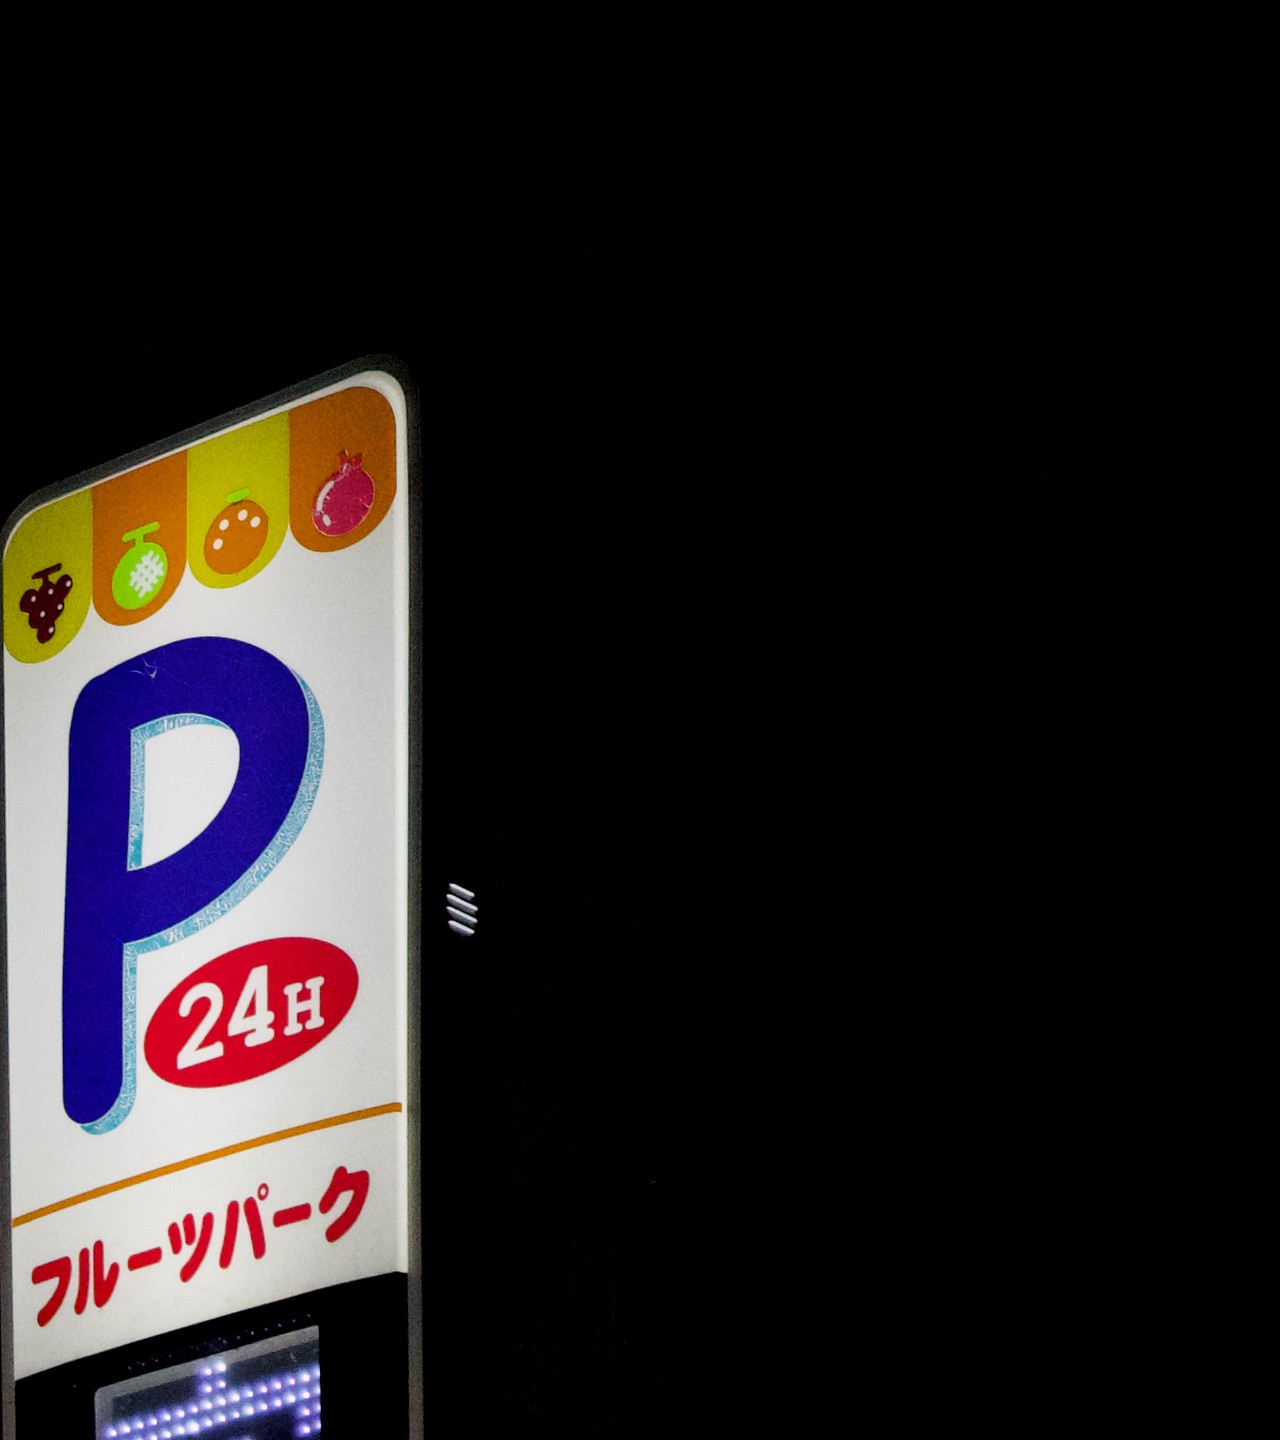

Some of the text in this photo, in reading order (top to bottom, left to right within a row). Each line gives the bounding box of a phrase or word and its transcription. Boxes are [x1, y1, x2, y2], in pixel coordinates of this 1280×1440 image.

[62, 636, 324, 1135] P
[176, 964, 326, 1070] 24H
[31, 1166, 370, 1327] フルーツパーク
